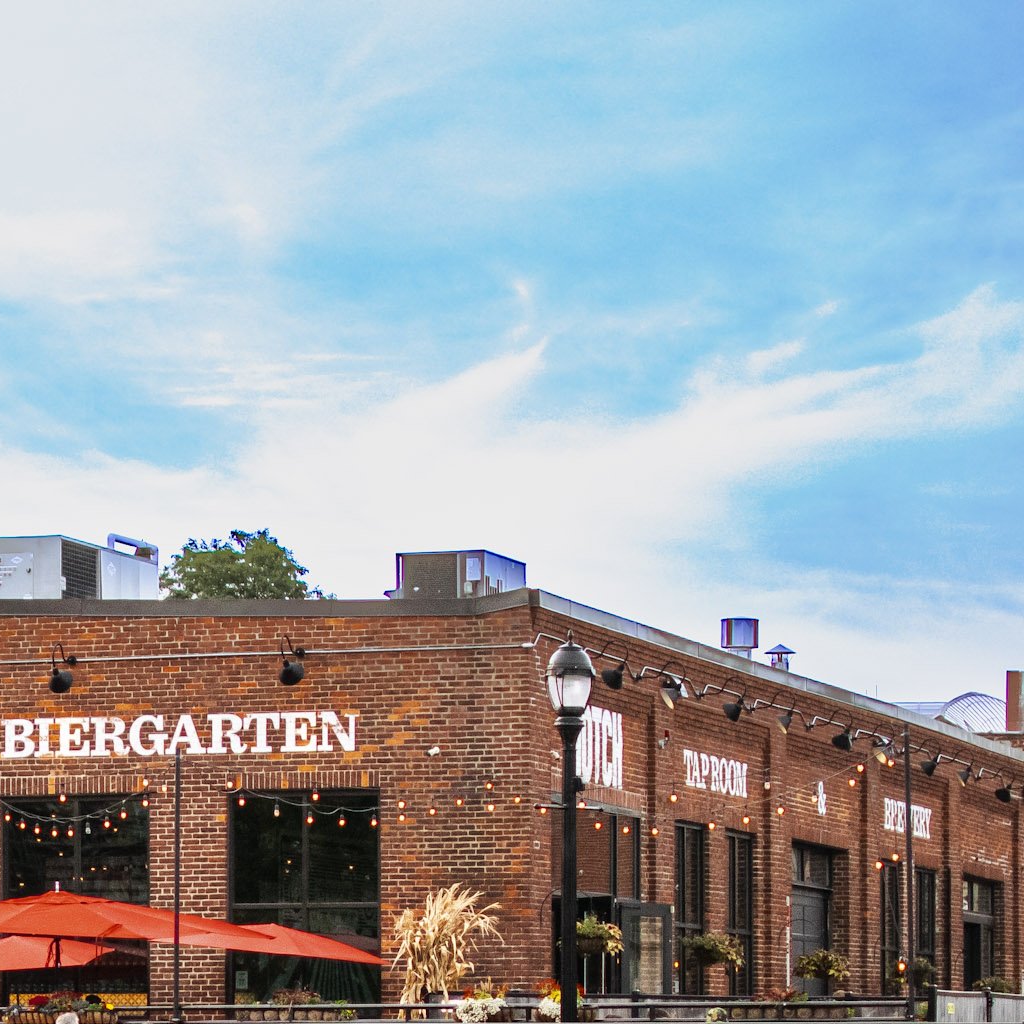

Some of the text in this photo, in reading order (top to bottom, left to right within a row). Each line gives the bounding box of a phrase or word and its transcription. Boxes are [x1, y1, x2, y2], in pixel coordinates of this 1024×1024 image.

[0, 711, 360, 758] BIERGARTEN
[683, 749, 710, 789] TAP
[709, 755, 748, 798] ROOM
[818, 781, 826, 816] &
